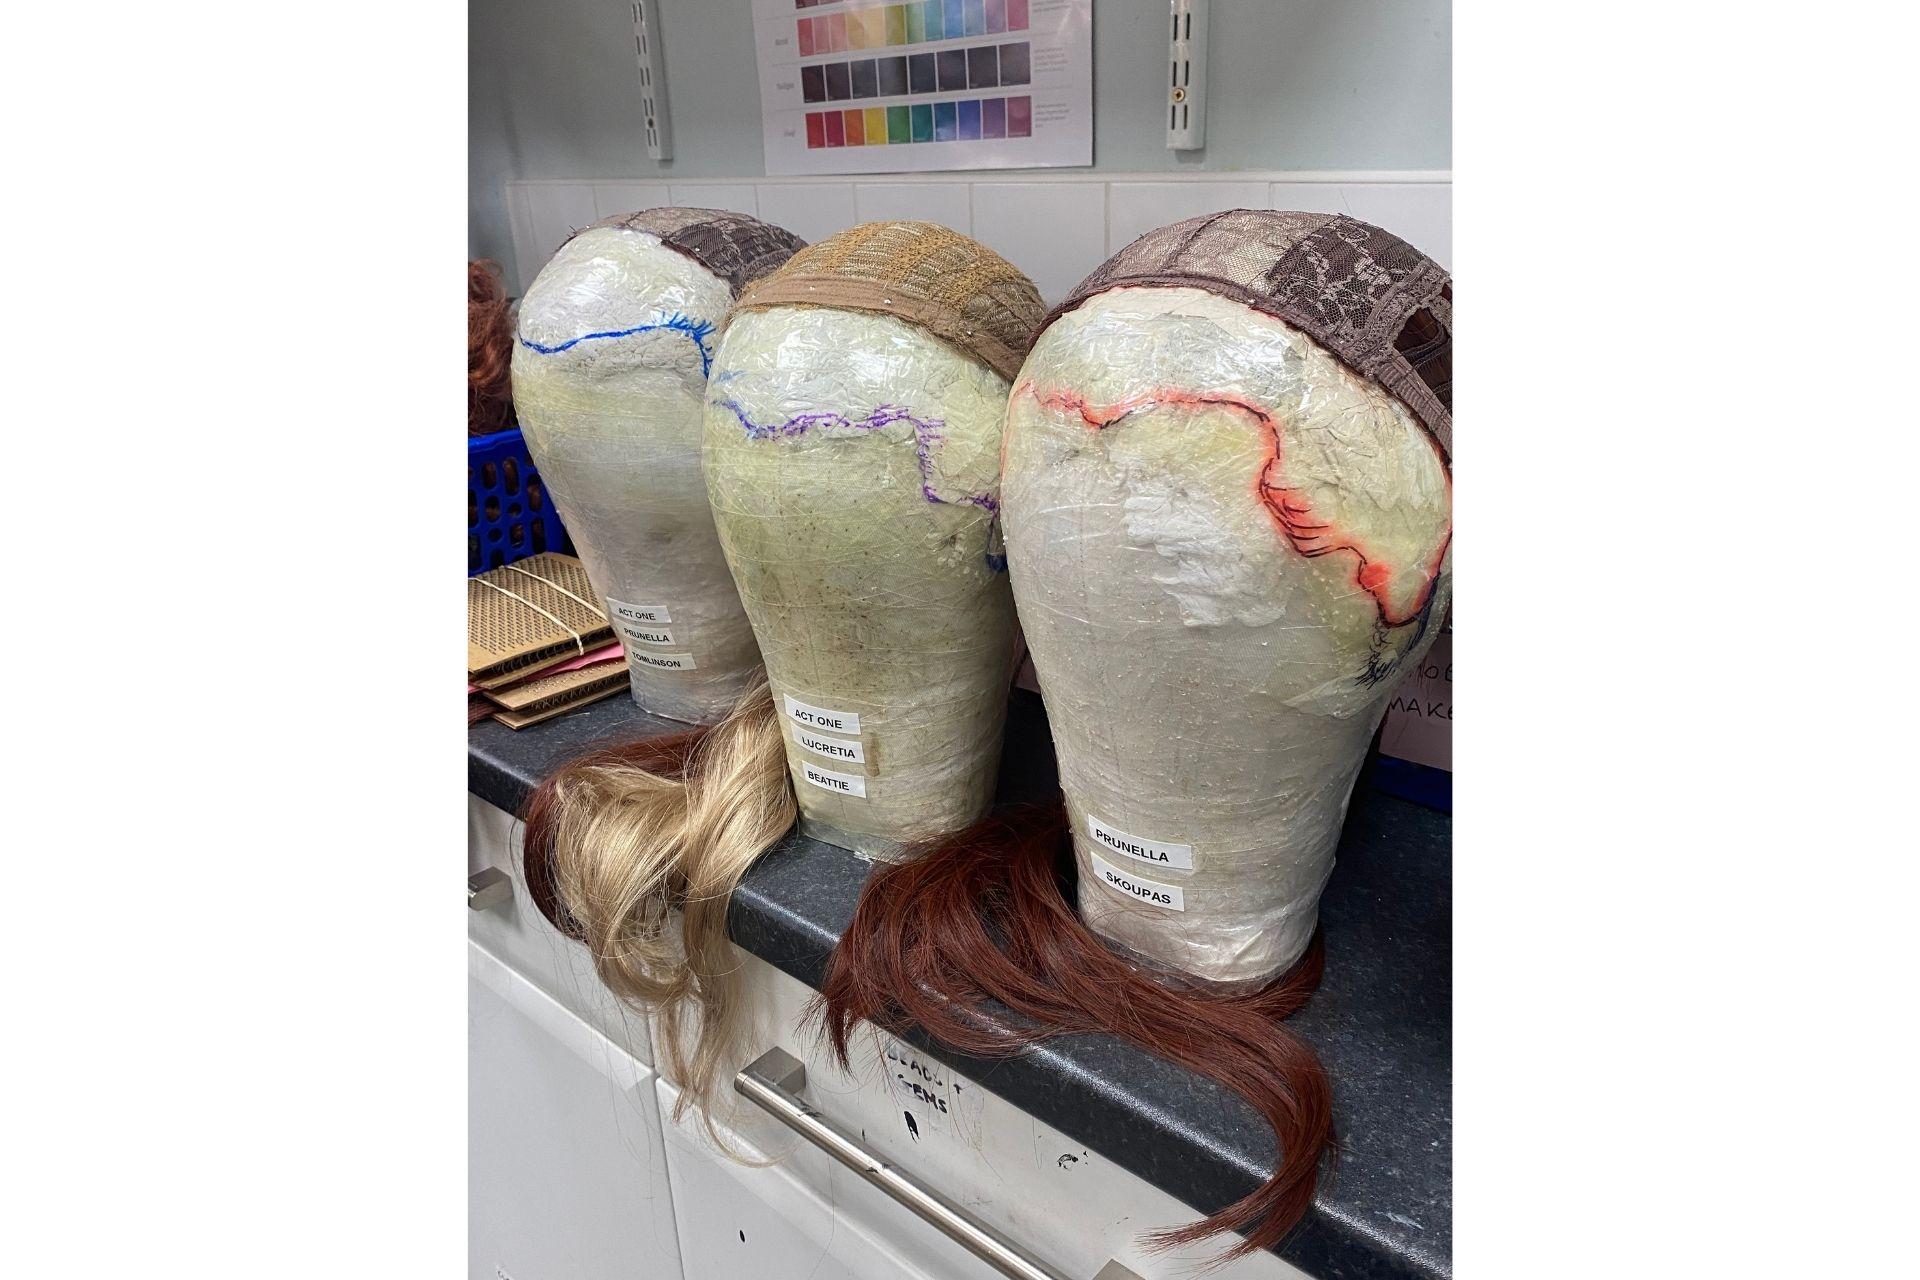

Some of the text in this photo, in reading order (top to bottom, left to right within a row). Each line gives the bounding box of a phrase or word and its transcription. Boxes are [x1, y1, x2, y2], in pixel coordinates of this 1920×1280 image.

[618, 607, 656, 621] ACT ONE
[623, 627, 670, 642] PRUNELLA
[631, 651, 681, 668] TOMLINSON
[795, 709, 843, 729] ACT ONE
[801, 736, 856, 759] LUCRETIA
[807, 770, 850, 791] BEATTIE
[1095, 828, 1170, 863] PRUNELLA
[1105, 871, 1172, 904] SKOUPAS
